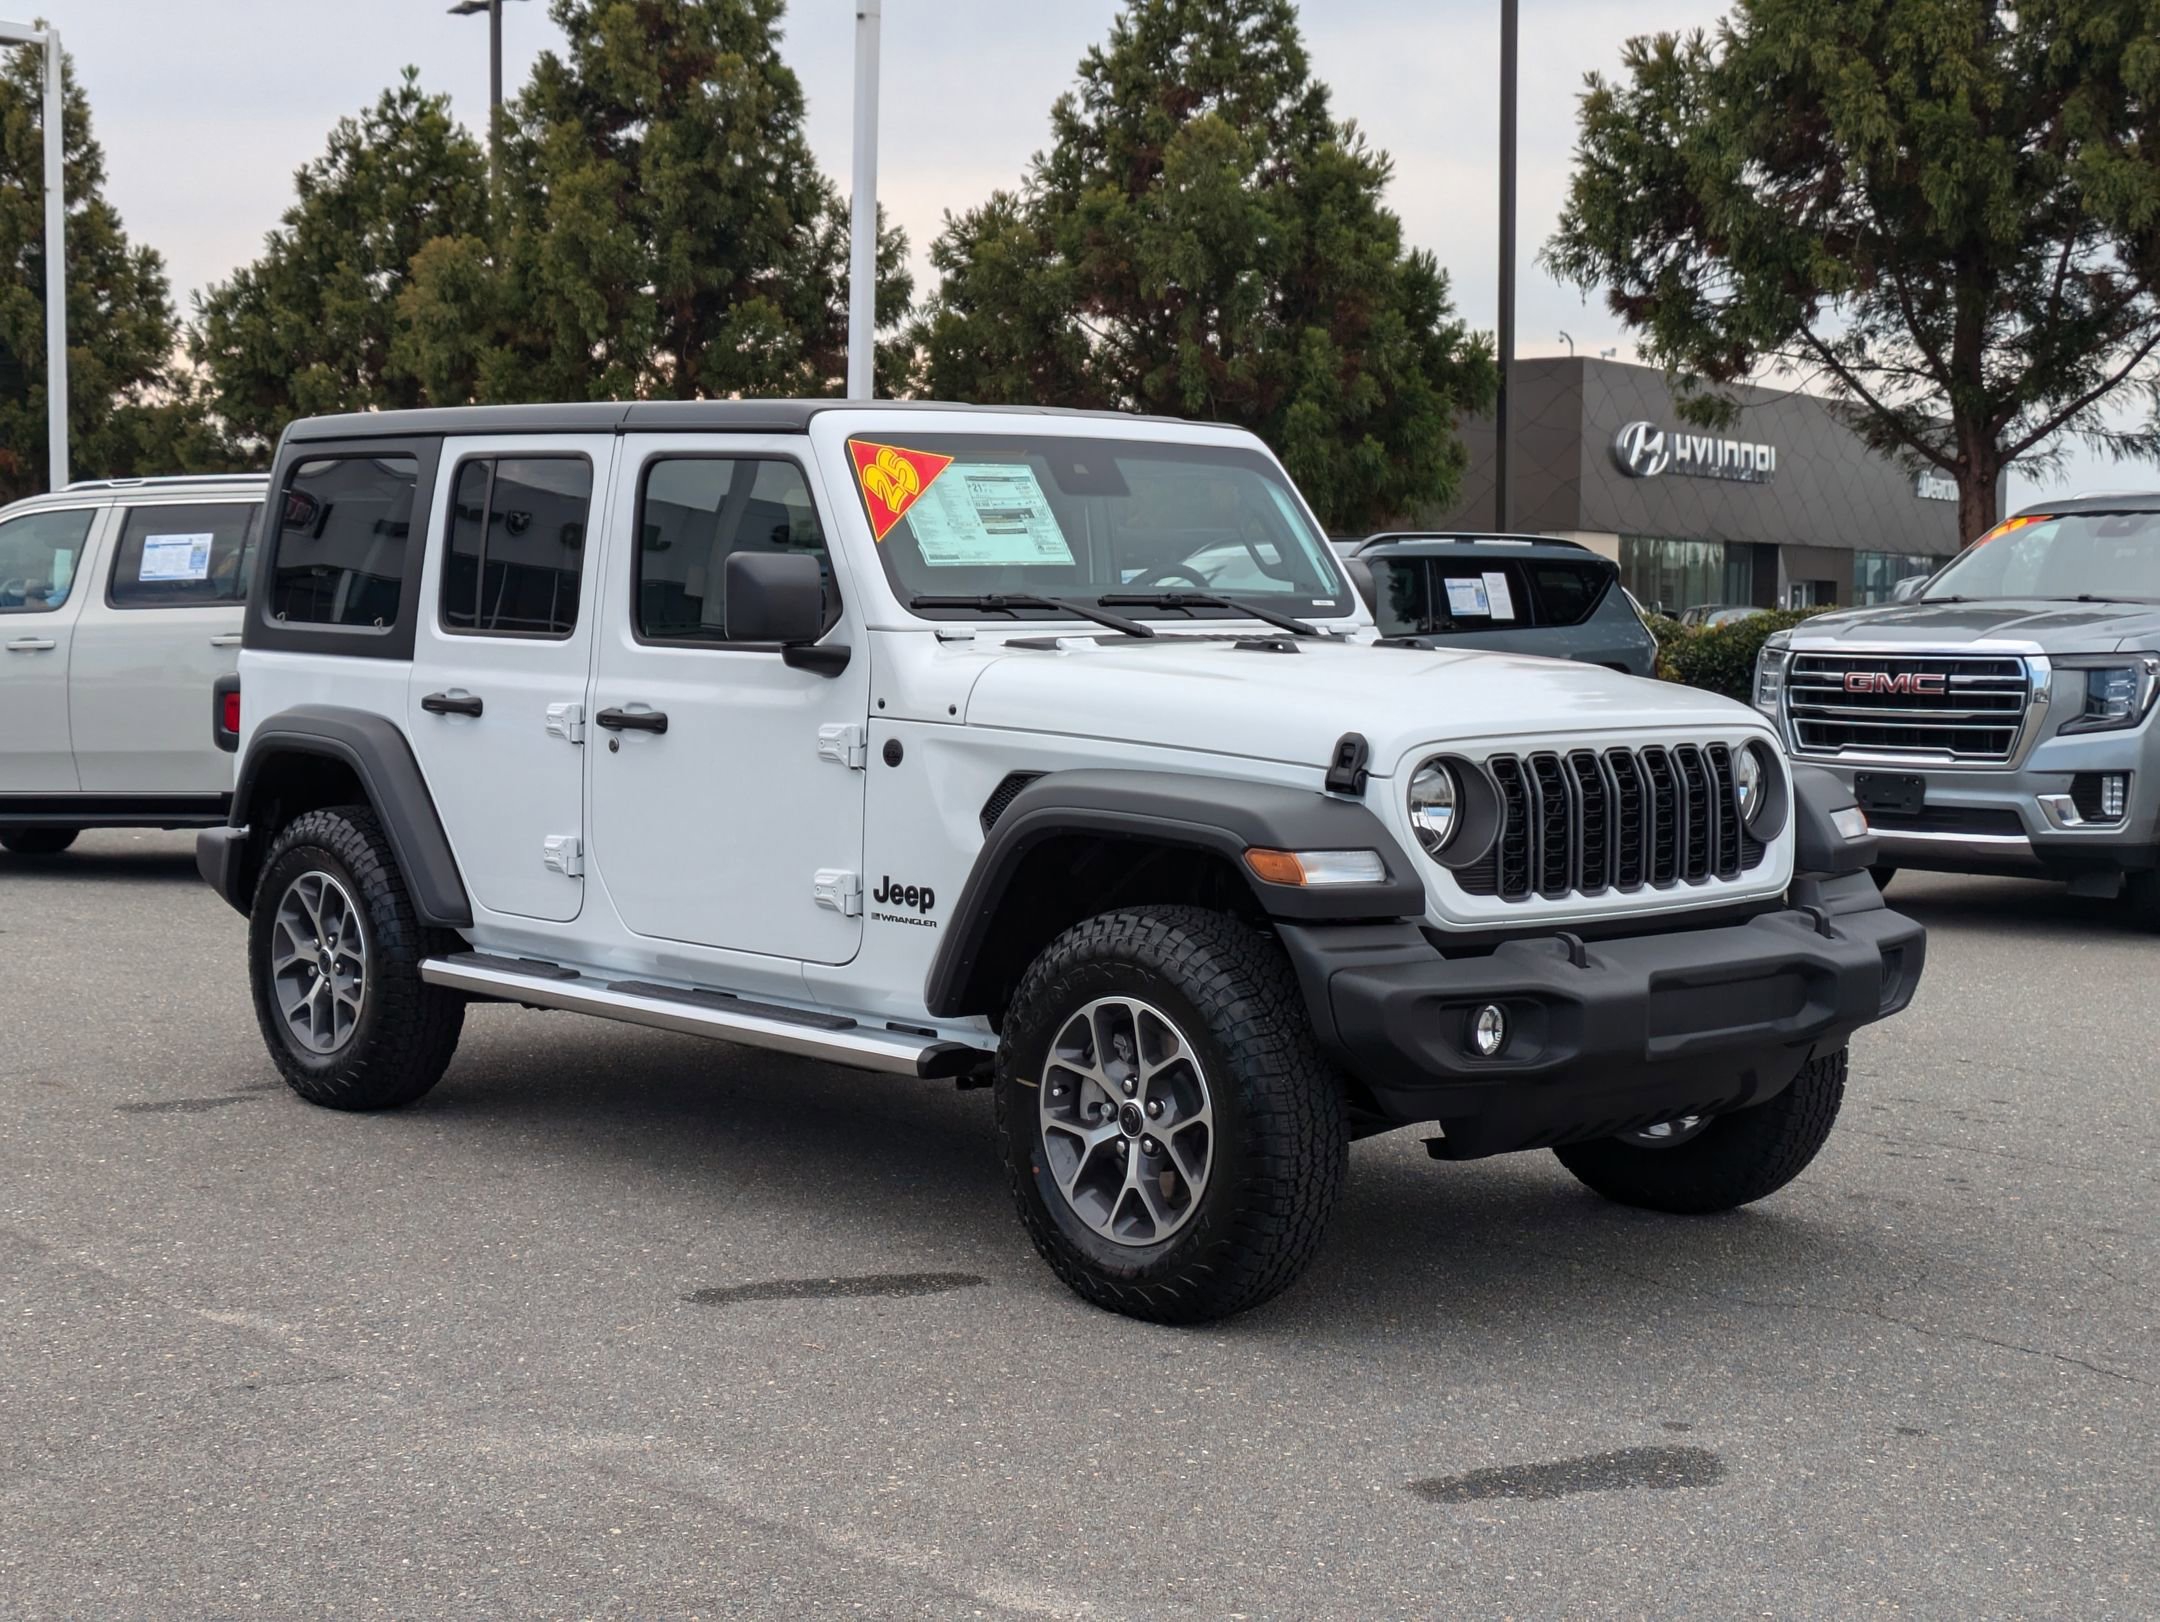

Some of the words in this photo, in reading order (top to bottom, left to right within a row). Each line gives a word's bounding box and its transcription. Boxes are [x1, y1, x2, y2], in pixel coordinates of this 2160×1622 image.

[1675, 433, 1775, 472] HYUNDAI
[863, 448, 919, 513] 25
[1844, 671, 1946, 694] GMC
[873, 875, 935, 914] Jeep
[881, 913, 937, 928] WRANGLER
